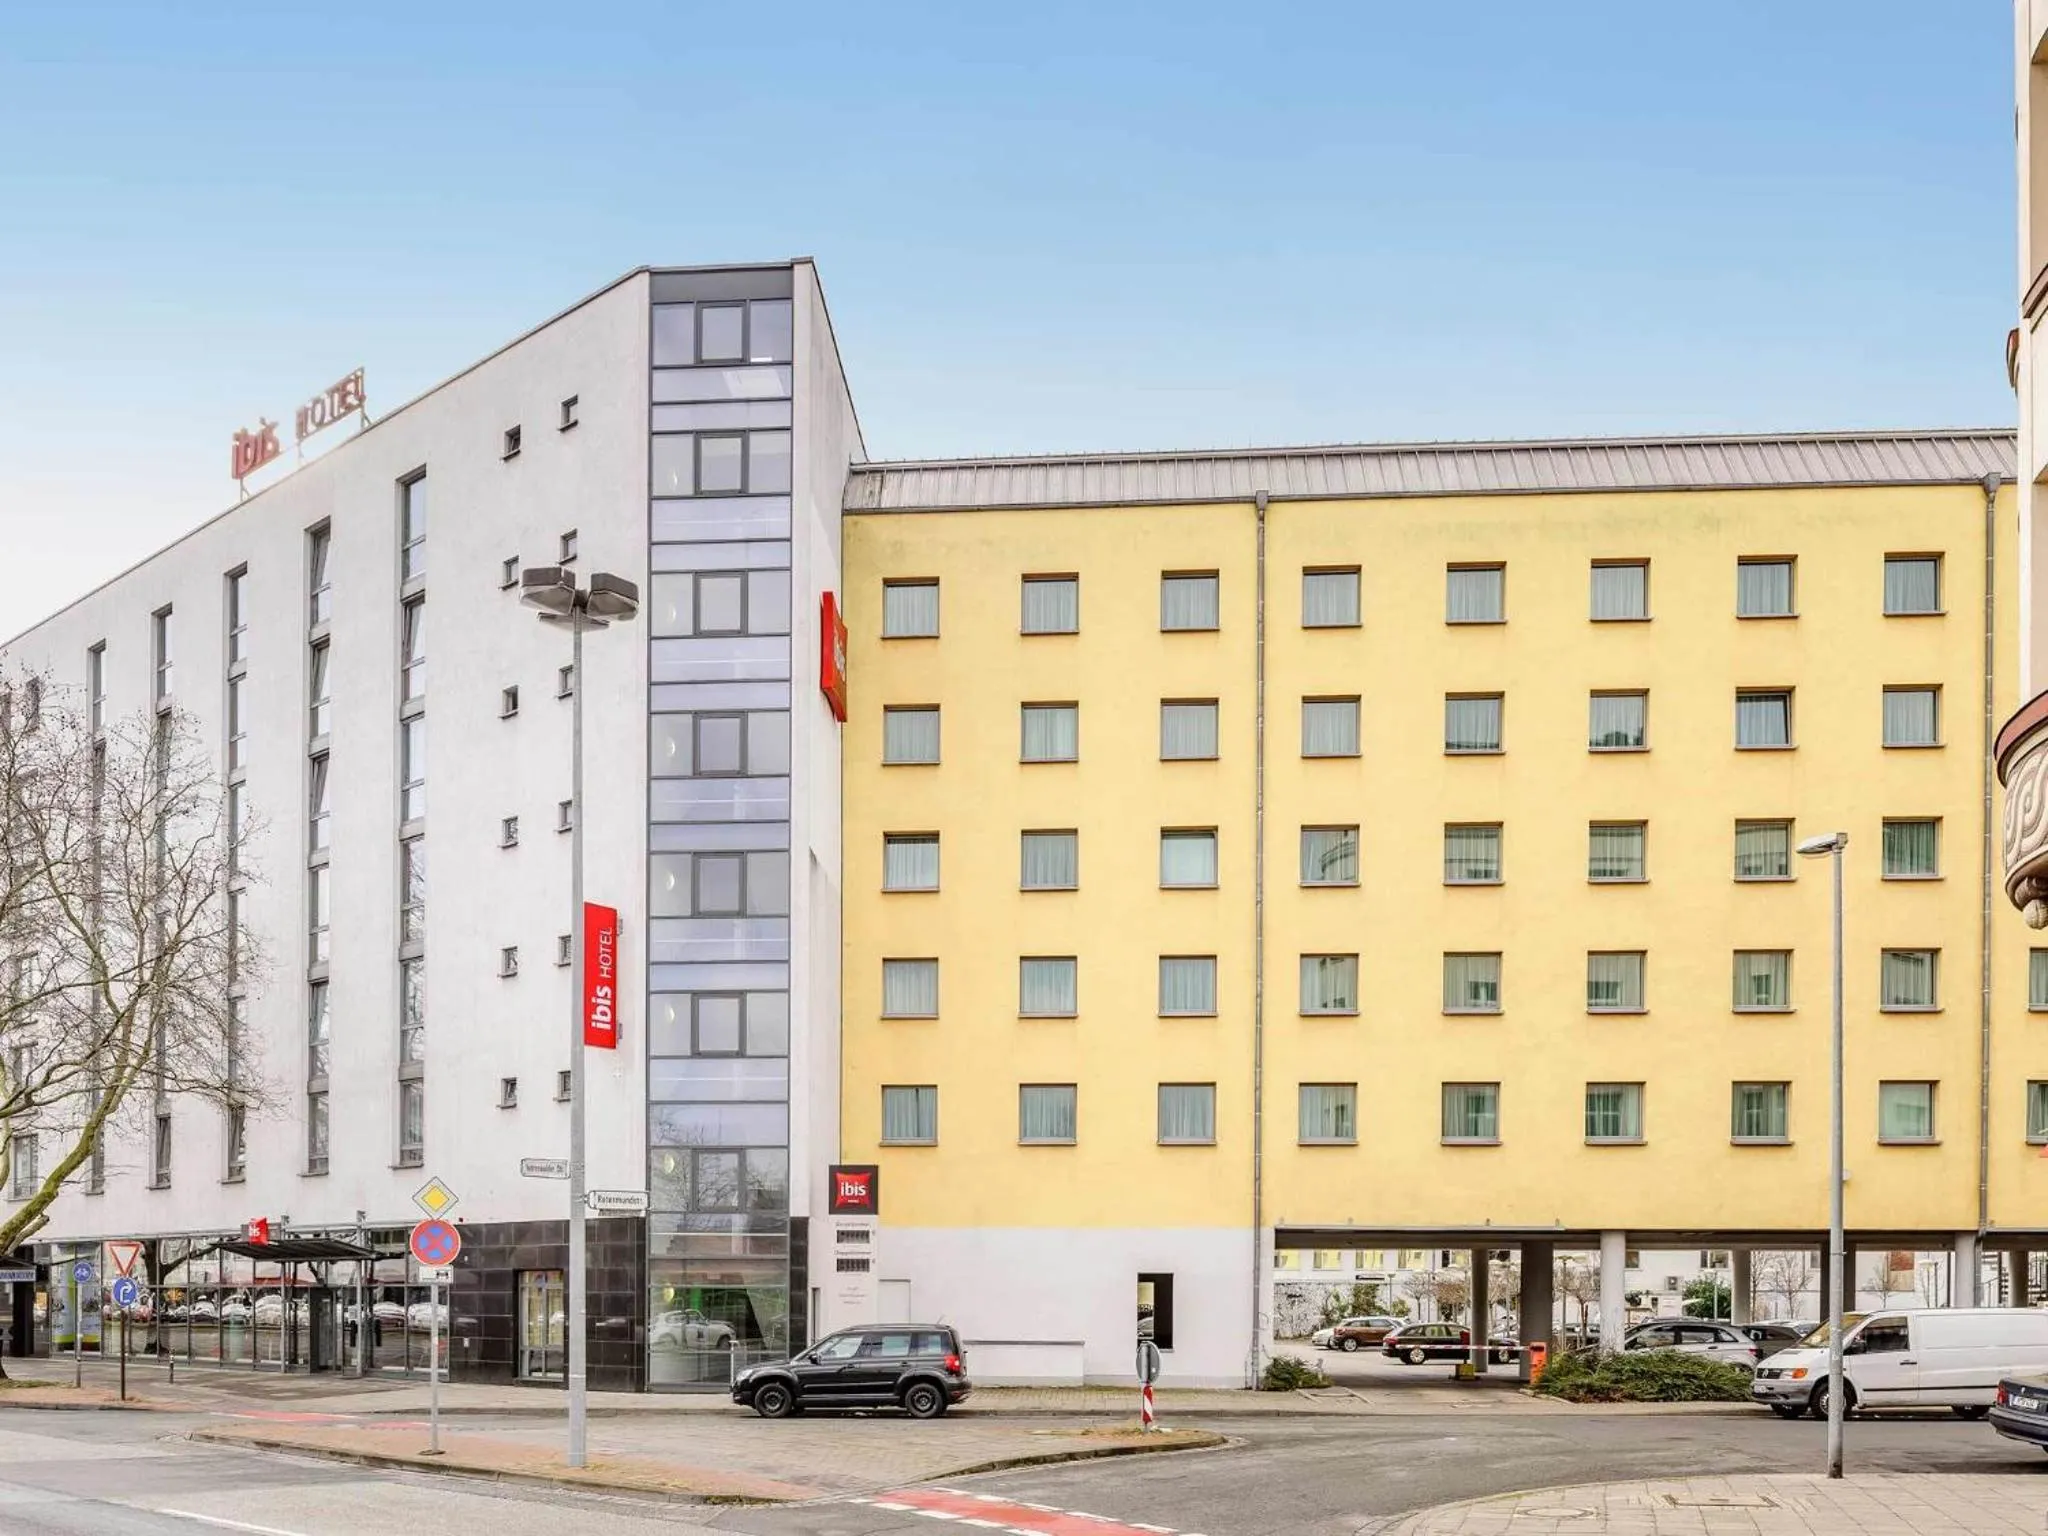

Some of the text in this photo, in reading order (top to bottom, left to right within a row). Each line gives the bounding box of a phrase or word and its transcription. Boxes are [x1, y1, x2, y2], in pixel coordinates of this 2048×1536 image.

[591, 927, 612, 1031] ibis HOTEL
[841, 1182, 866, 1196] ibis
